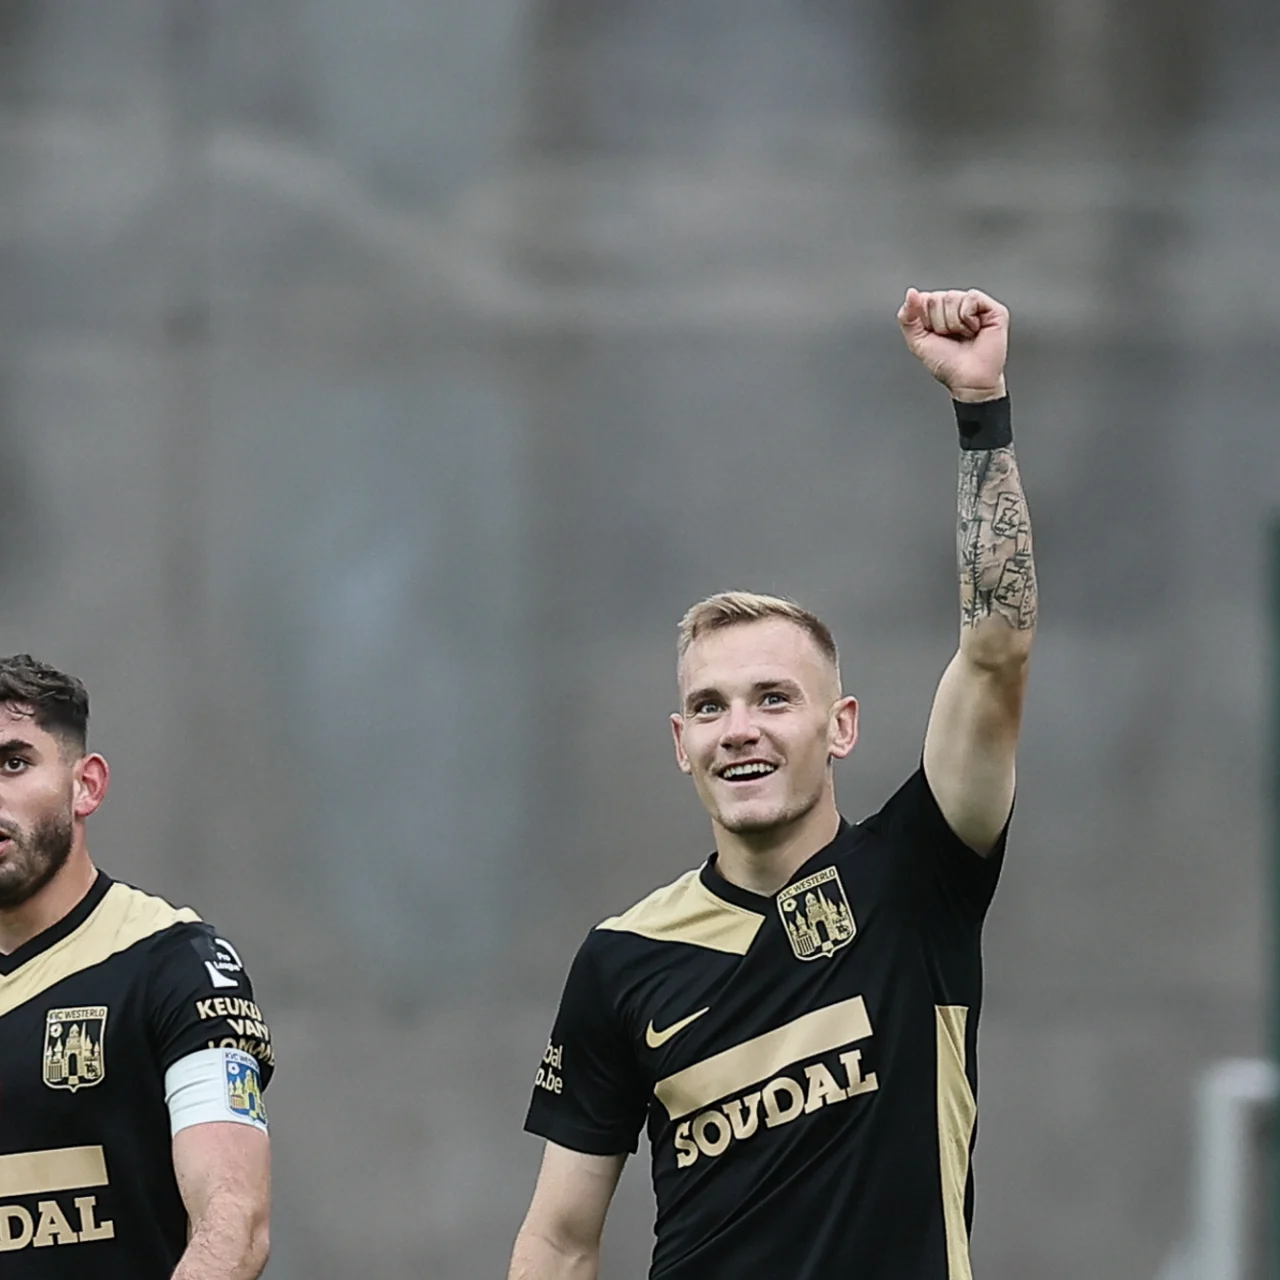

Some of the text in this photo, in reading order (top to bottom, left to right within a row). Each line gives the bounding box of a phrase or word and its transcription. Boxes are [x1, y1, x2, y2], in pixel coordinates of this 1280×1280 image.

[793, 868, 836, 892] WESTERLO
[216, 951, 231, 961] Pro
[65, 1008, 105, 1019] WESTERLO
[226, 1018, 270, 1041] VAN
[674, 1049, 879, 1169] SOUDAL
